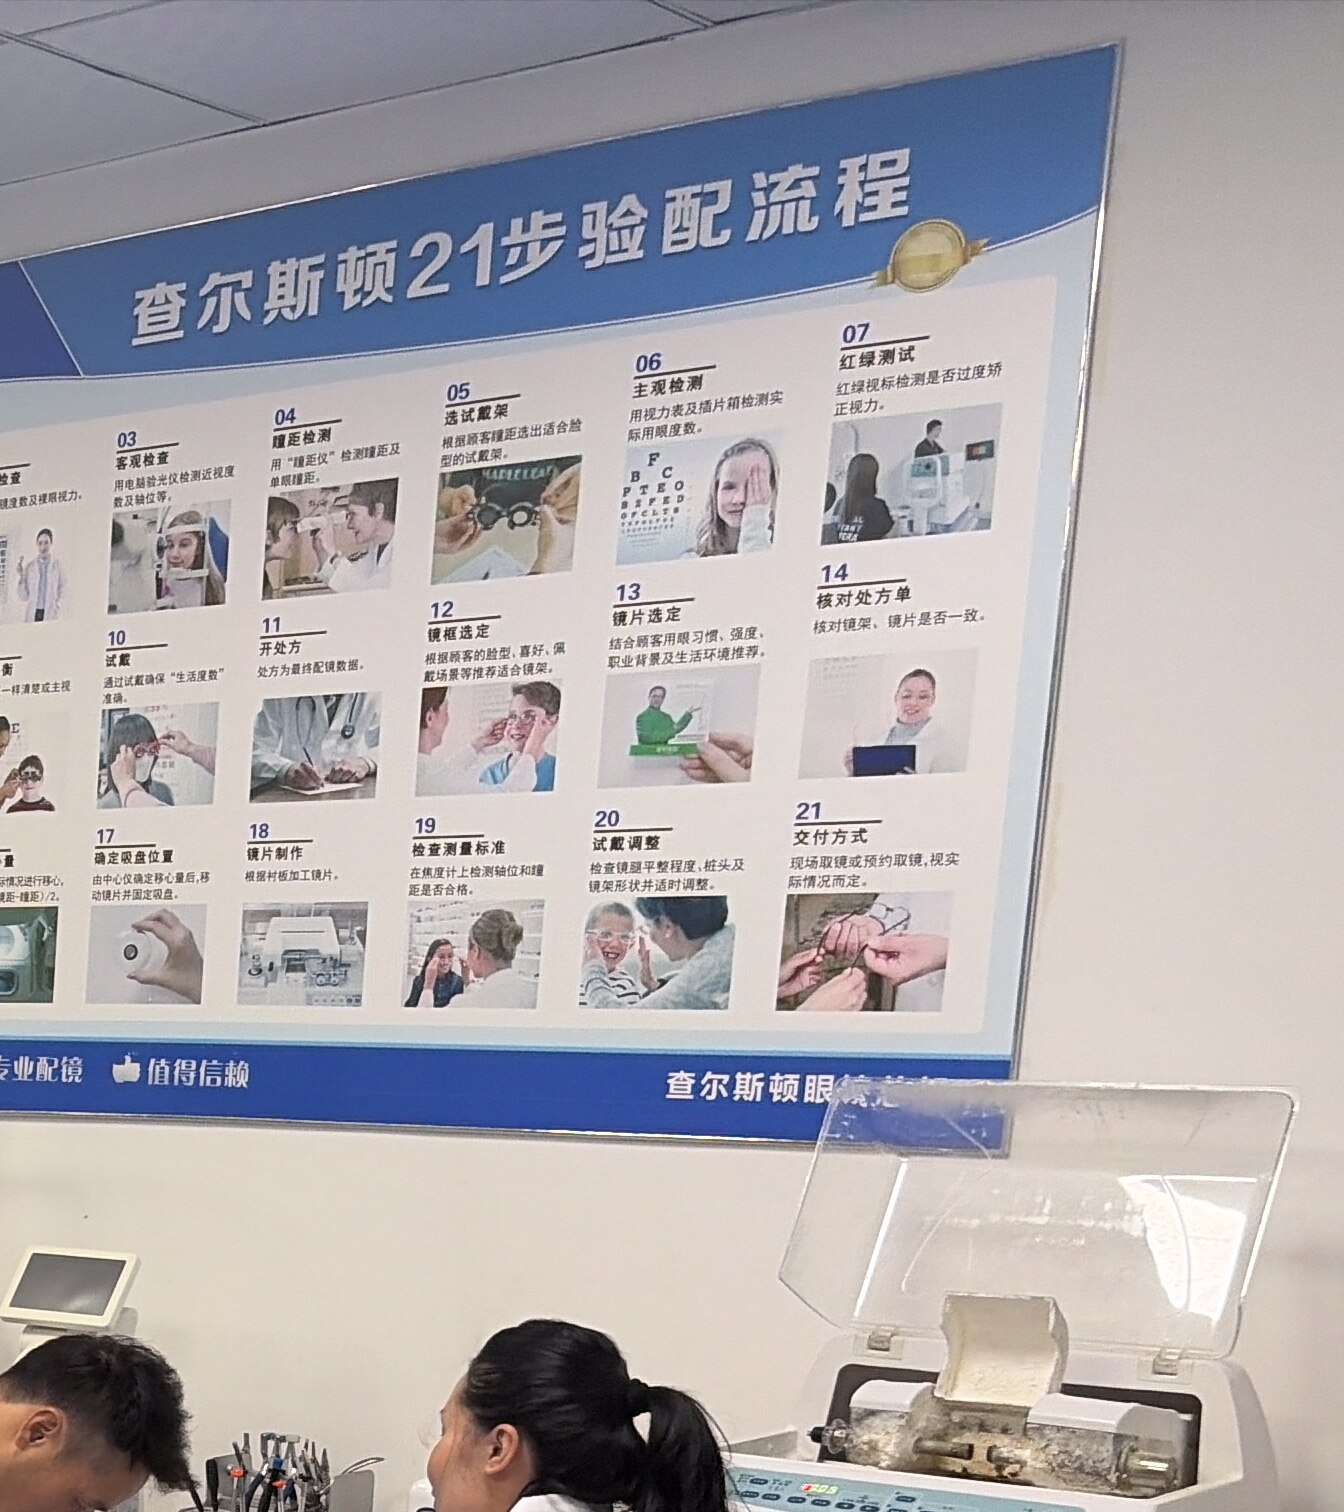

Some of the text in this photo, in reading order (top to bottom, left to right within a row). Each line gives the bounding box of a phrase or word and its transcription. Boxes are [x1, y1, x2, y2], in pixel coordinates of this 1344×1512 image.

[131, 149, 911, 346] 查尔斯顿21步验配流程
[842, 323, 870, 343] 07
[635, 353, 661, 373] 06
[839, 346, 915, 371] 红绿测试
[632, 374, 703, 399] 主观检测
[836, 362, 1002, 397] 红绿视标检测是否过度矫
[446, 383, 470, 401] 05
[444, 404, 509, 426] 选试戴架
[630, 390, 784, 423] 用视力表及插片箱检测实
[834, 398, 885, 416] 正视力。
[274, 408, 296, 426] 04
[117, 431, 136, 448] 03
[272, 428, 332, 449] 瞳距检测
[441, 418, 583, 449] 根据顾客瞳距选出适合脸
[115, 450, 169, 470] 客观检查
[821, 563, 848, 582] 14
[615, 583, 641, 601] 13
[816, 585, 912, 610] 核对处方单
[430, 602, 454, 619] 12
[612, 606, 681, 627] 镜片选定
[262, 617, 282, 634] 11
[427, 623, 490, 643] 镜框选定
[108, 630, 126, 646] 10
[259, 639, 303, 657] 开处方
[105, 652, 131, 668] 试戴
[594, 810, 620, 828] 20
[794, 802, 822, 821] 21
[249, 823, 270, 840] 18
[415, 817, 436, 834] 19
[97, 829, 115, 844] 17
[592, 834, 660, 853] 试戴调整
[793, 827, 869, 847] 交付方式
[94, 848, 174, 866] 确定吸盘位置
[246, 845, 304, 862] 镜片制作
[411, 839, 506, 858] 检查测量标准
[787, 872, 868, 889] 际情况而定。
[147, 1056, 251, 1089] 值得信赖
